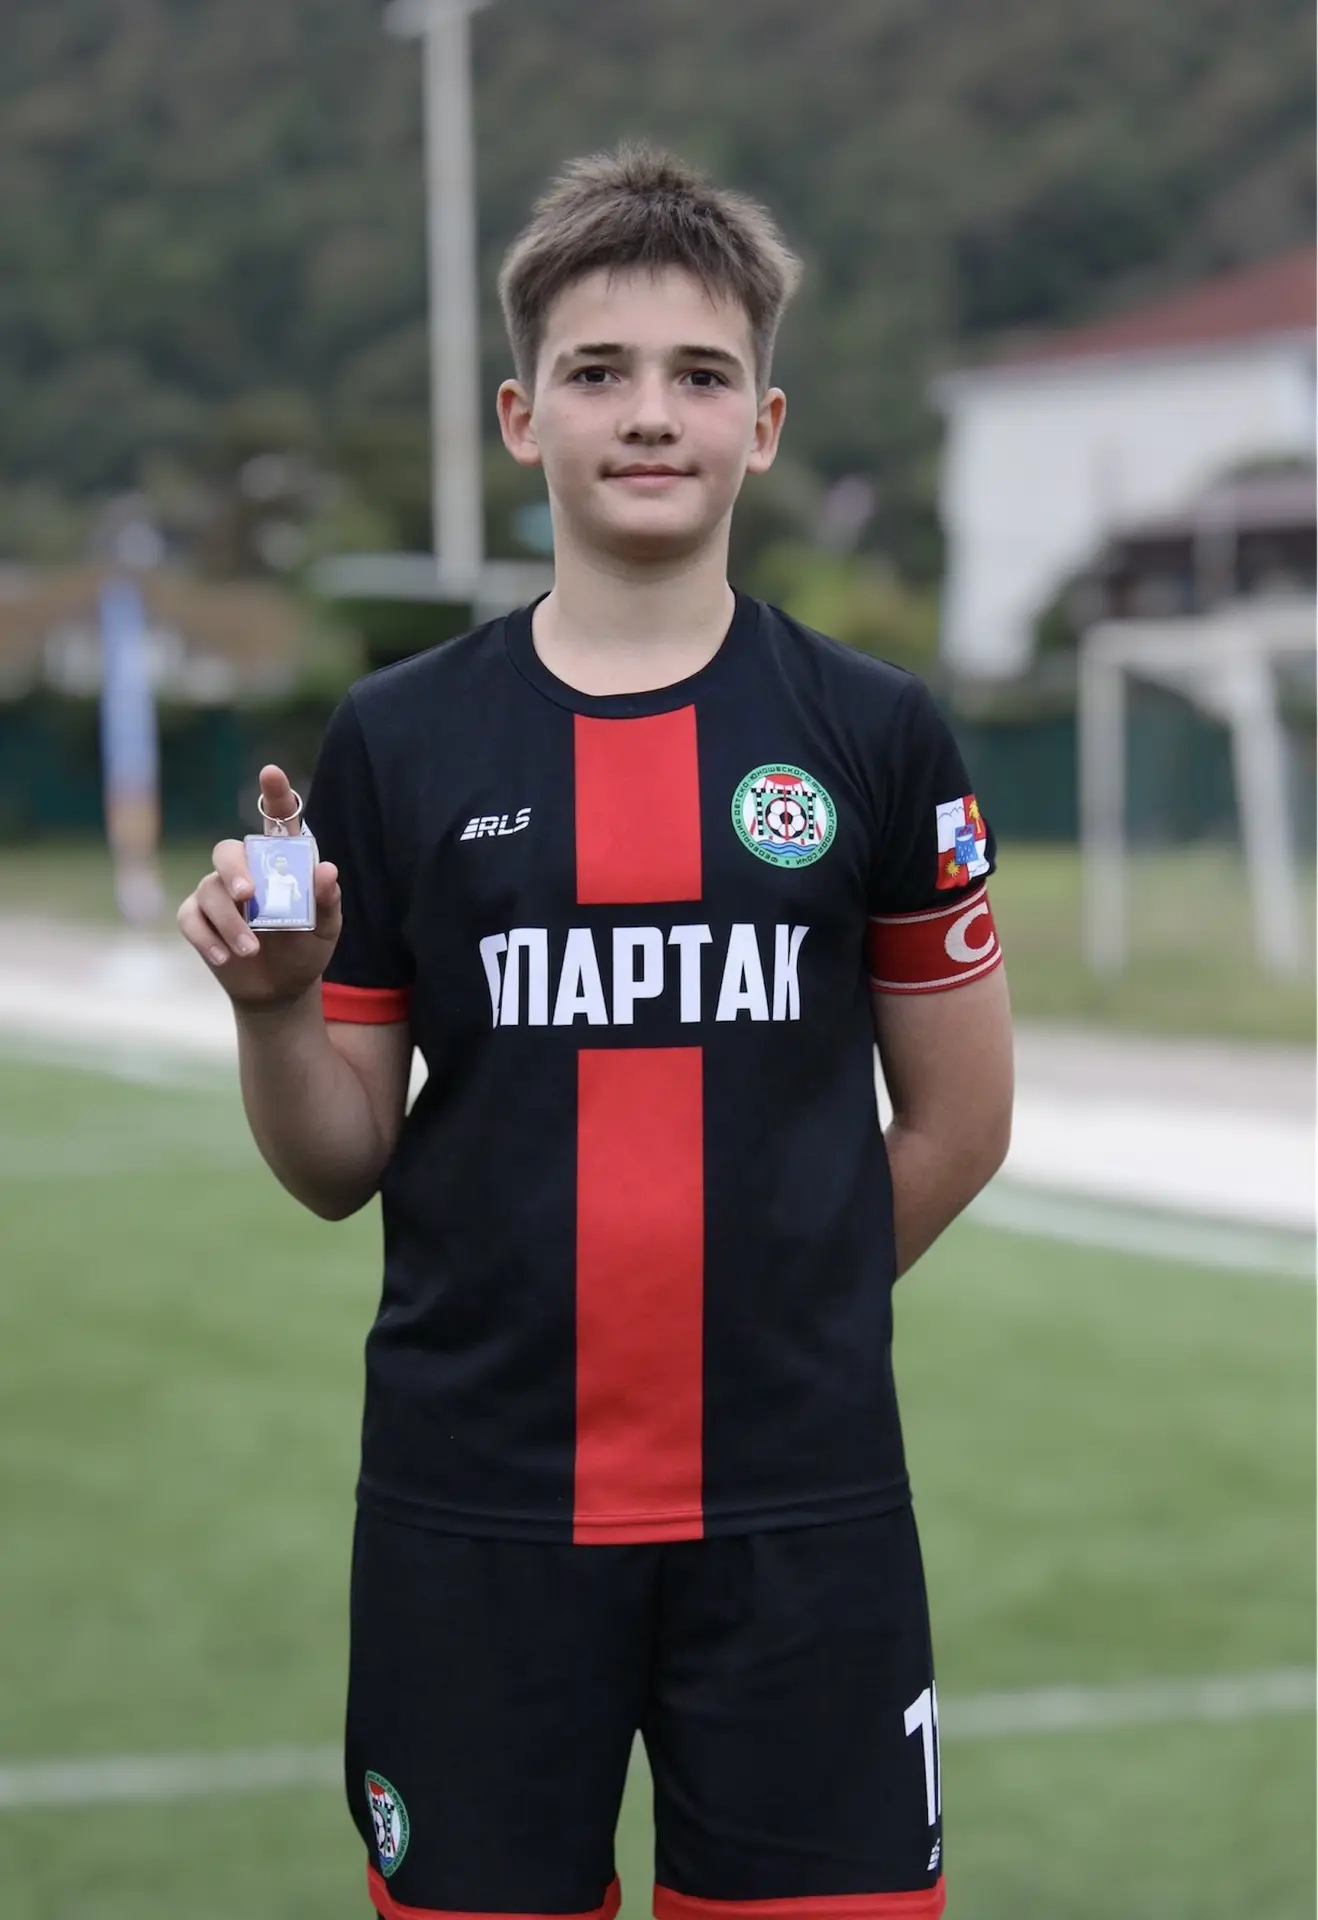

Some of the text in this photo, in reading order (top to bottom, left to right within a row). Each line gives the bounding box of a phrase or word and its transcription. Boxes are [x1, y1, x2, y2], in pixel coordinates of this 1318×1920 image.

[733, 765, 835, 865] ФЕДЕРАЦИЯ ДЕТСКО-ЮНОШЕСКОГО ФУТБОЛА ГОРОДА СОЧИ
[944, 901, 995, 963] C
